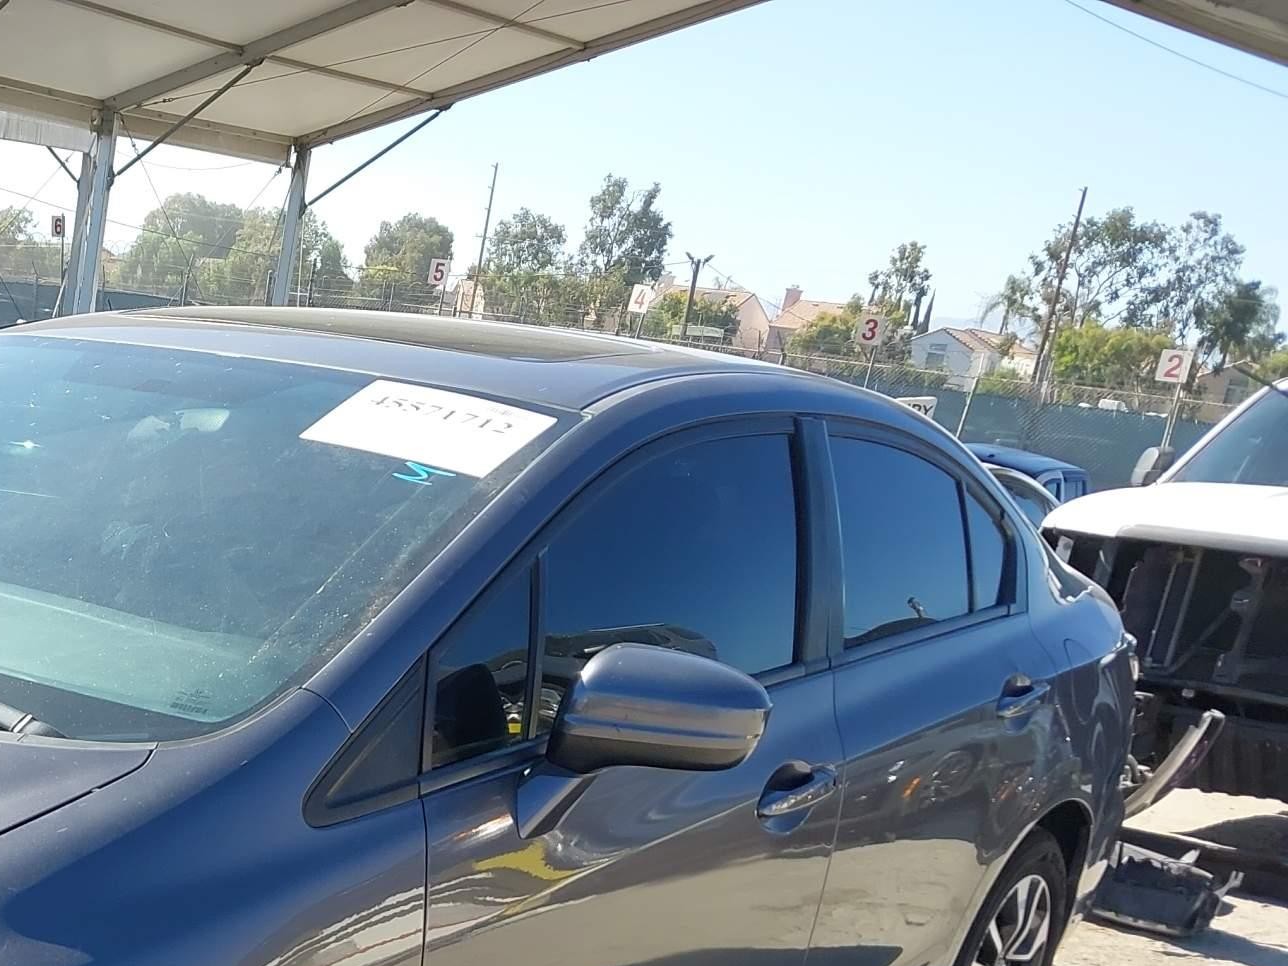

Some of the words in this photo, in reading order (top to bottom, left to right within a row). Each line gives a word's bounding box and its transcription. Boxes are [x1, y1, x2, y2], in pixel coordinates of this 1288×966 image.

[53, 218, 62, 235] 6
[432, 262, 446, 282] 5
[633, 291, 645, 309] 4
[862, 318, 879, 341] 3
[1164, 354, 1184, 378] 2
[371, 395, 513, 434] 45571712
